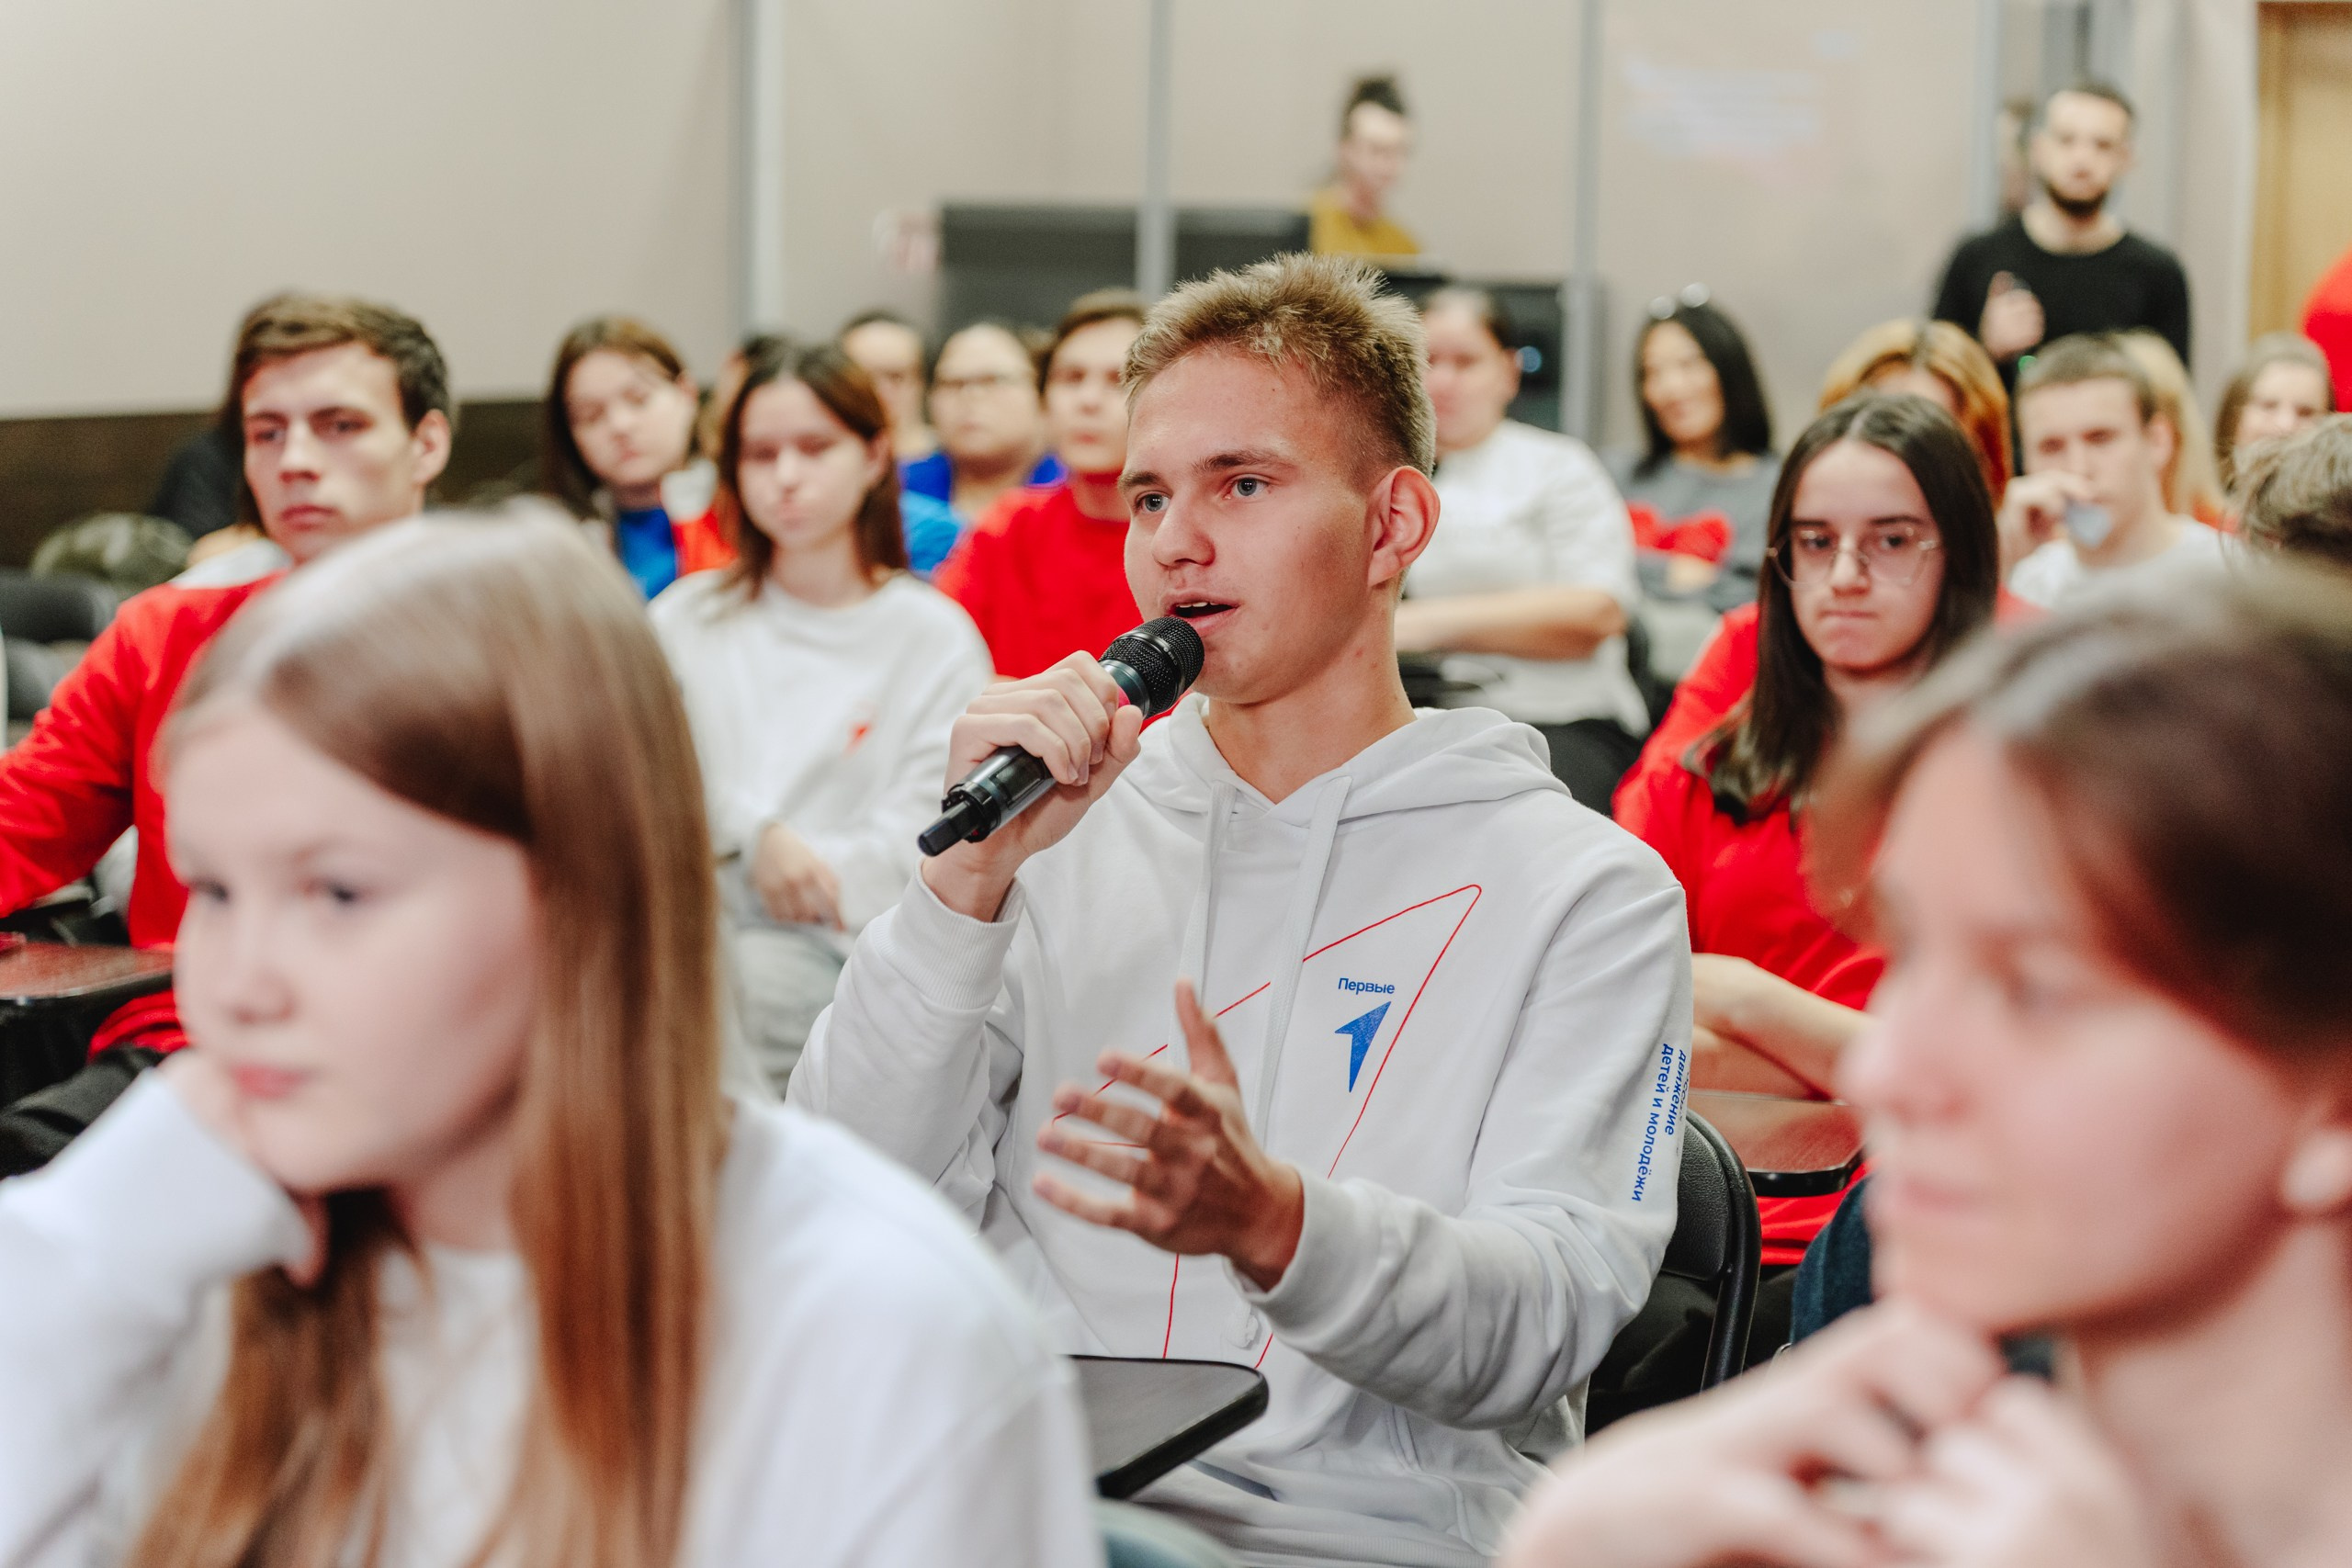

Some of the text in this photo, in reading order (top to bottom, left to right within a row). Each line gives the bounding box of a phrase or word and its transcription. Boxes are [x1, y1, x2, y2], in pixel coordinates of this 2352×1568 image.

[1338, 977, 1396, 995] Первые
[1632, 1043, 1674, 1201] детей и молодёжи
[1665, 1049, 1687, 1135] движение
